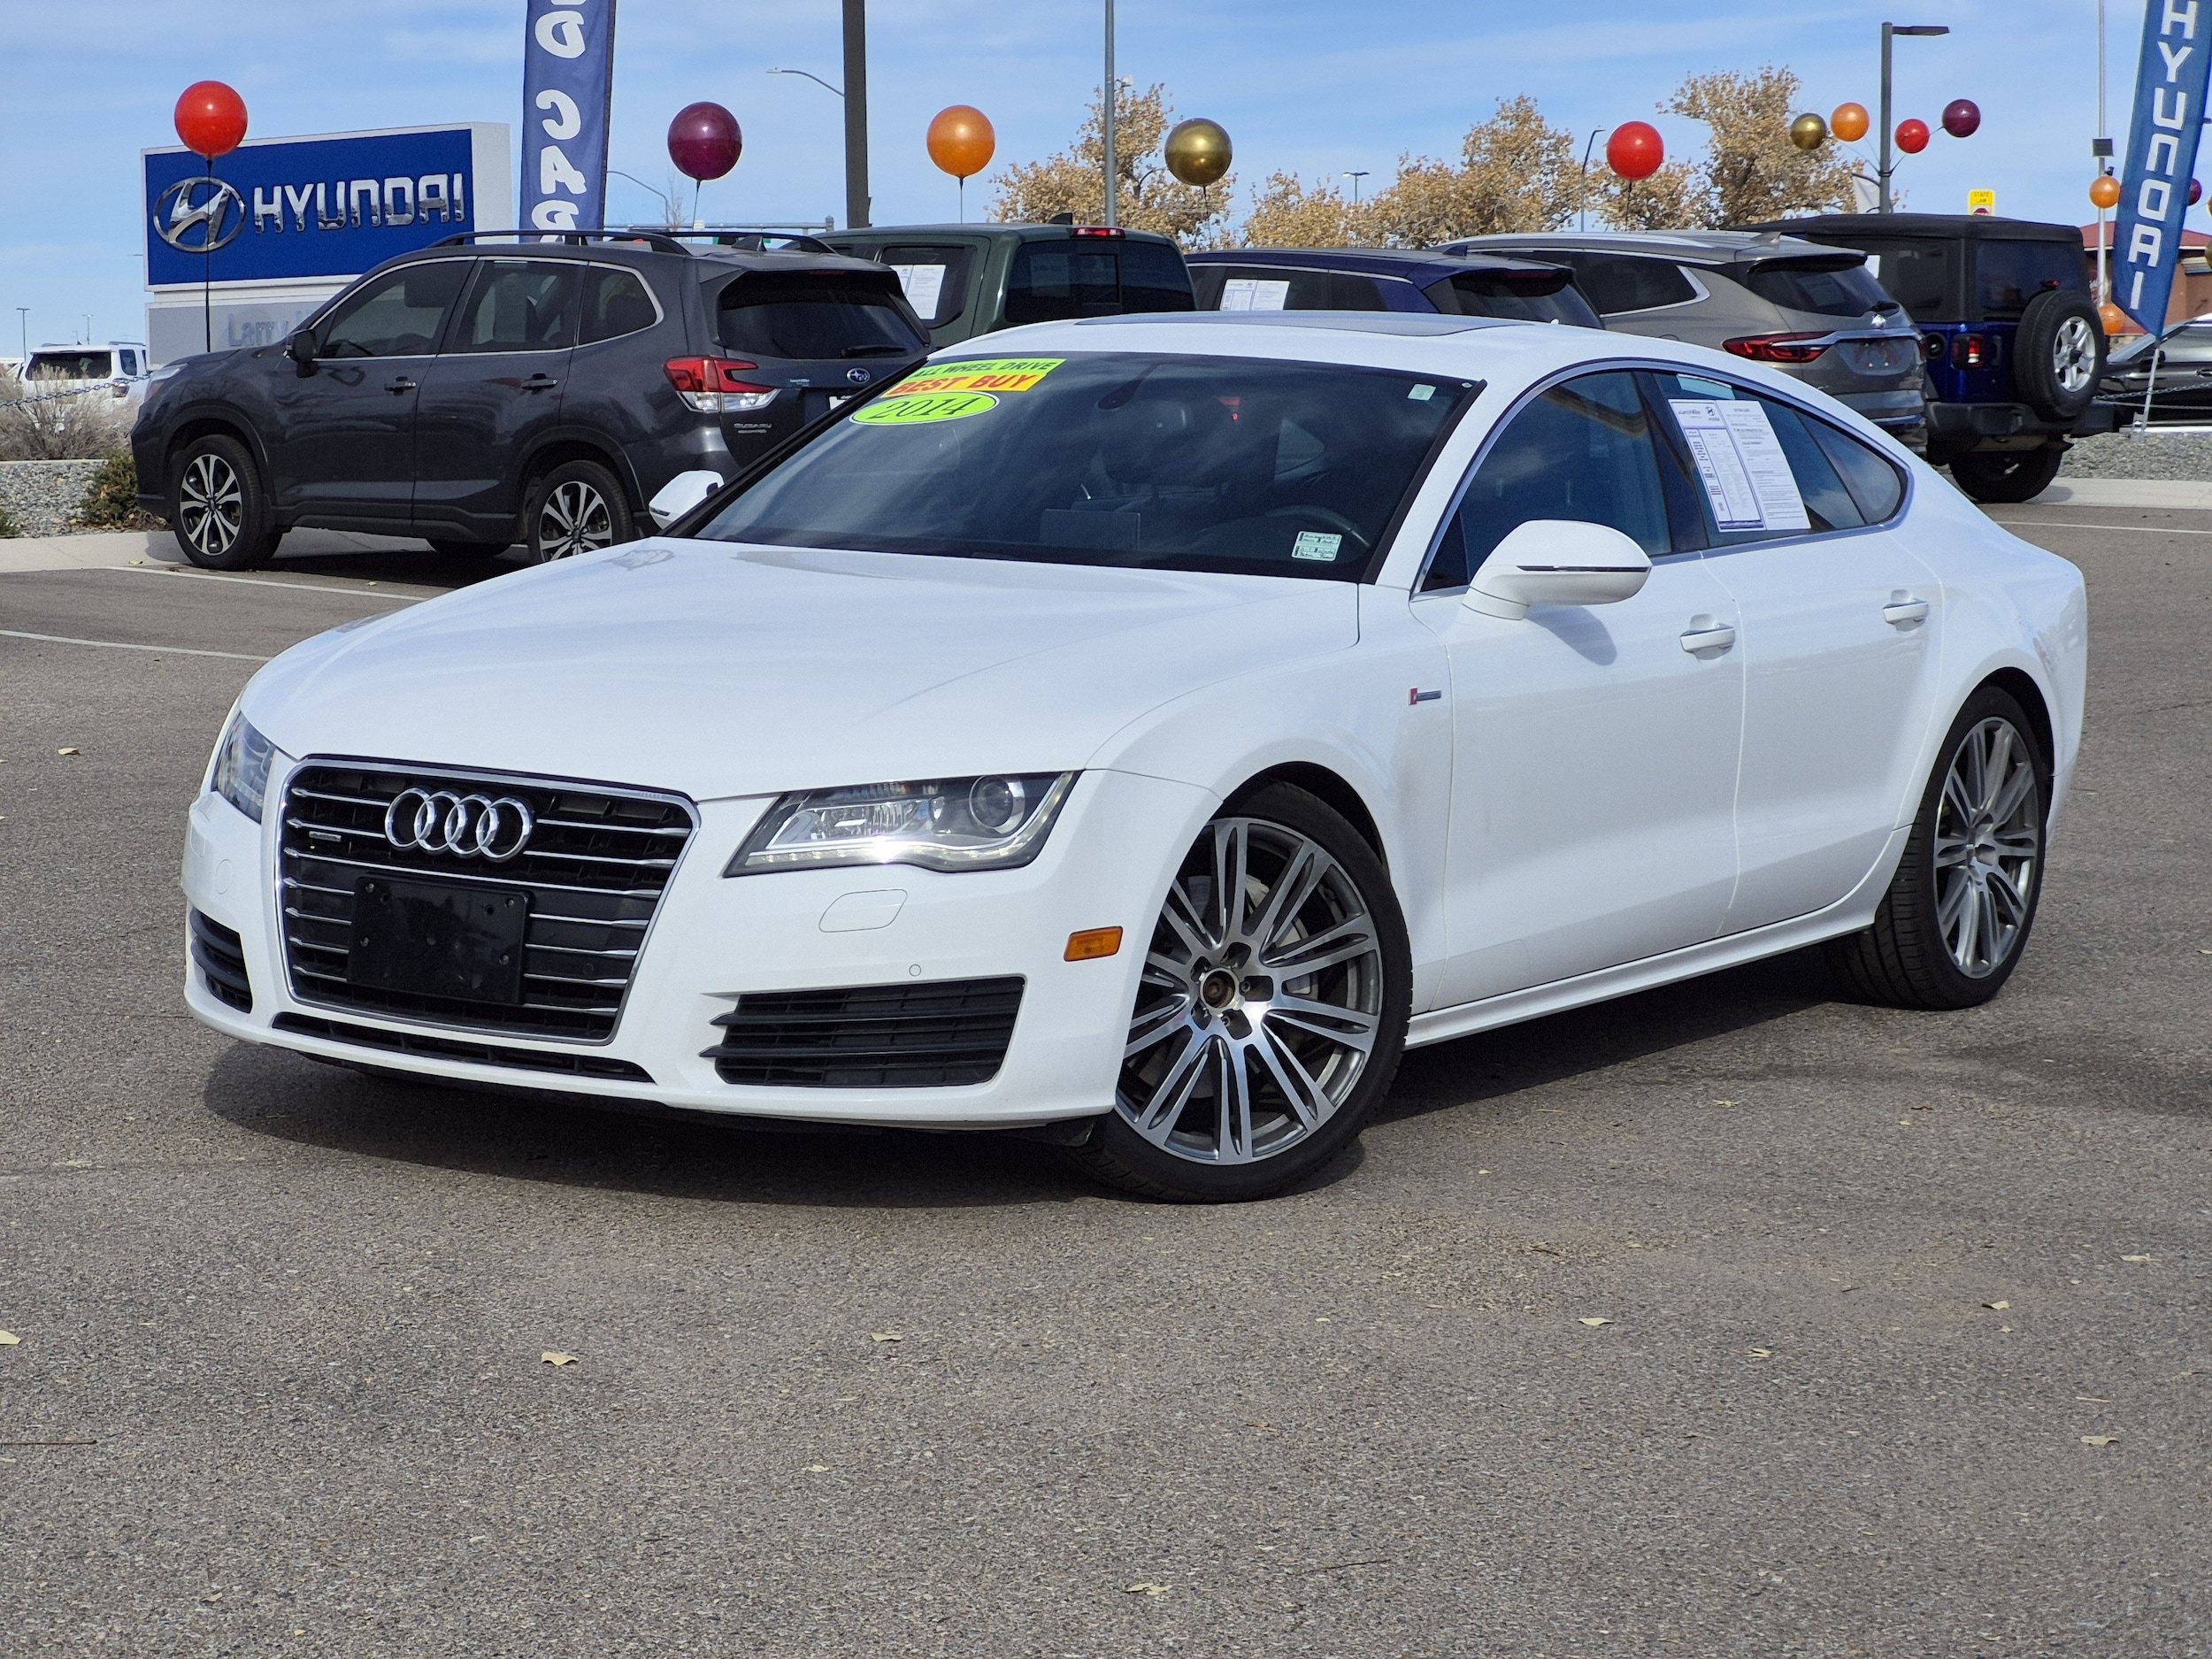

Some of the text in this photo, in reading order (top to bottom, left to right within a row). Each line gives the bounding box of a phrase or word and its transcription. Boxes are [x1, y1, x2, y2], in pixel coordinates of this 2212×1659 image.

[253, 173, 465, 234] HYUNDAI
[909, 362, 1058, 379] ALL WHEEL DRIVE
[887, 374, 1041, 396] BEST BUY
[867, 396, 982, 419] 2014
